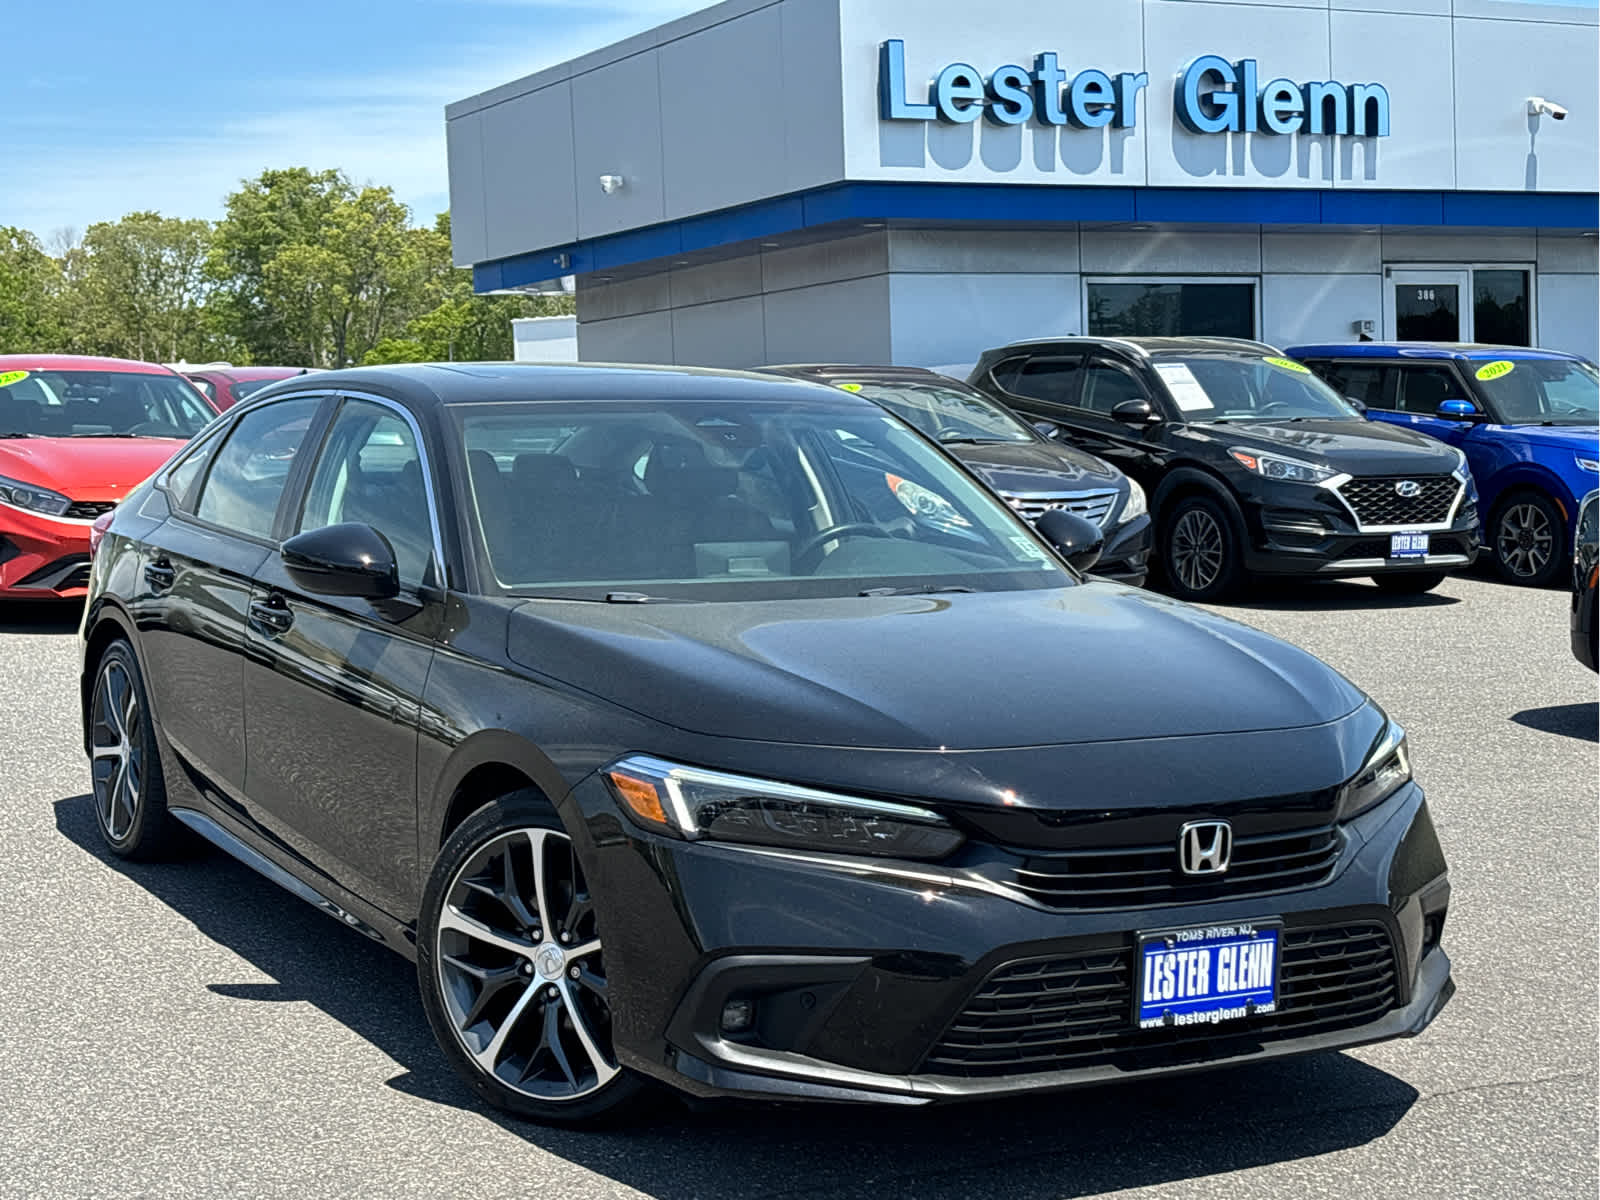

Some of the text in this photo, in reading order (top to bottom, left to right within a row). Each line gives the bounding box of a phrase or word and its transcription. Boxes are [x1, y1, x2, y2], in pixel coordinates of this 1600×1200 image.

[879, 38, 1391, 137] Lester Glenn
[1484, 362, 1507, 378] 2021
[1176, 930, 1204, 943] TOMS
[1143, 942, 1274, 1002] LESTER GLENN
